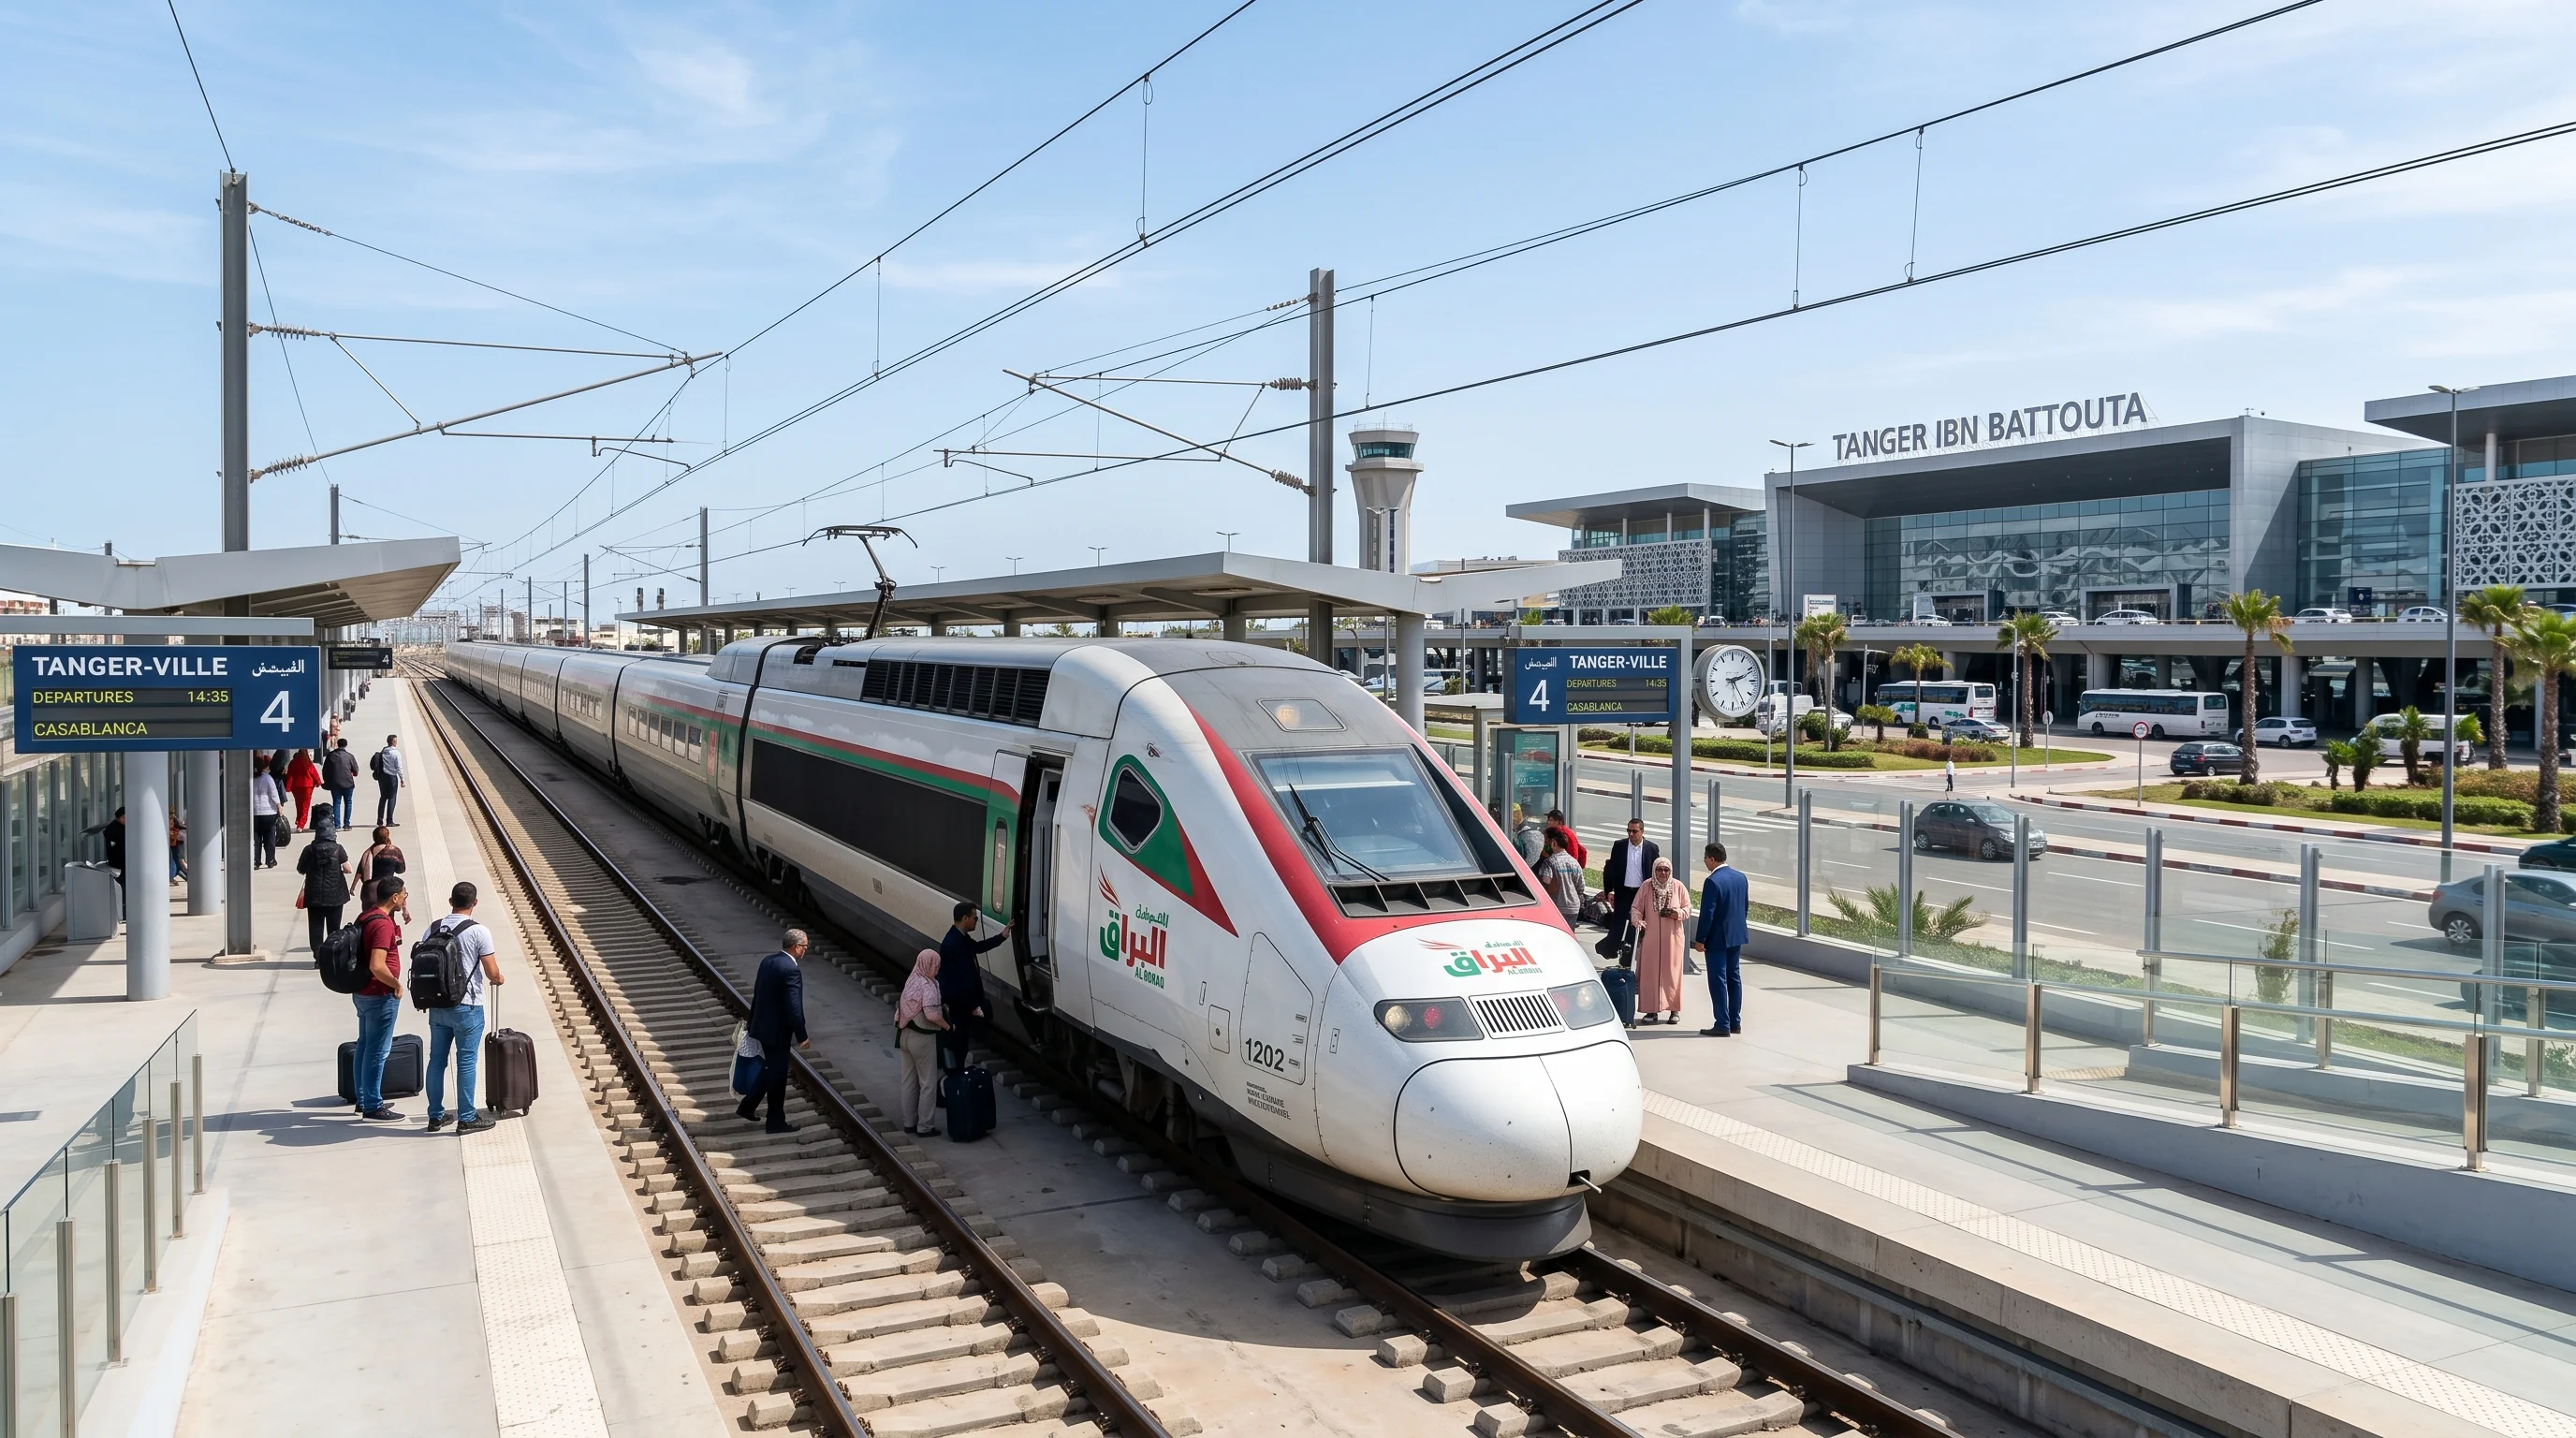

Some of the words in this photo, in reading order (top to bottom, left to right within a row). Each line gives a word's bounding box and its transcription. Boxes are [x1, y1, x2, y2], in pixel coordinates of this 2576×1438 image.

[1833, 423, 1928, 461] TANGER
[1936, 415, 1979, 448] IBN
[1989, 392, 2148, 442] BATTOUTA
[32, 656, 228, 676] TANGER-VILLE
[381, 654, 390, 665] 4
[1569, 655, 1667, 669] TANGER-VILLE
[1566, 679, 1617, 688] DEPARTURES
[33, 691, 134, 704] DEPARTURES
[187, 690, 229, 703] 14:35
[1529, 679, 1550, 712] 4
[259, 690, 295, 733] 4
[1566, 702, 1623, 712] CASABLANCA
[34, 722, 148, 737] CASABLANCA
[1245, 1037, 1284, 1073] 1202
